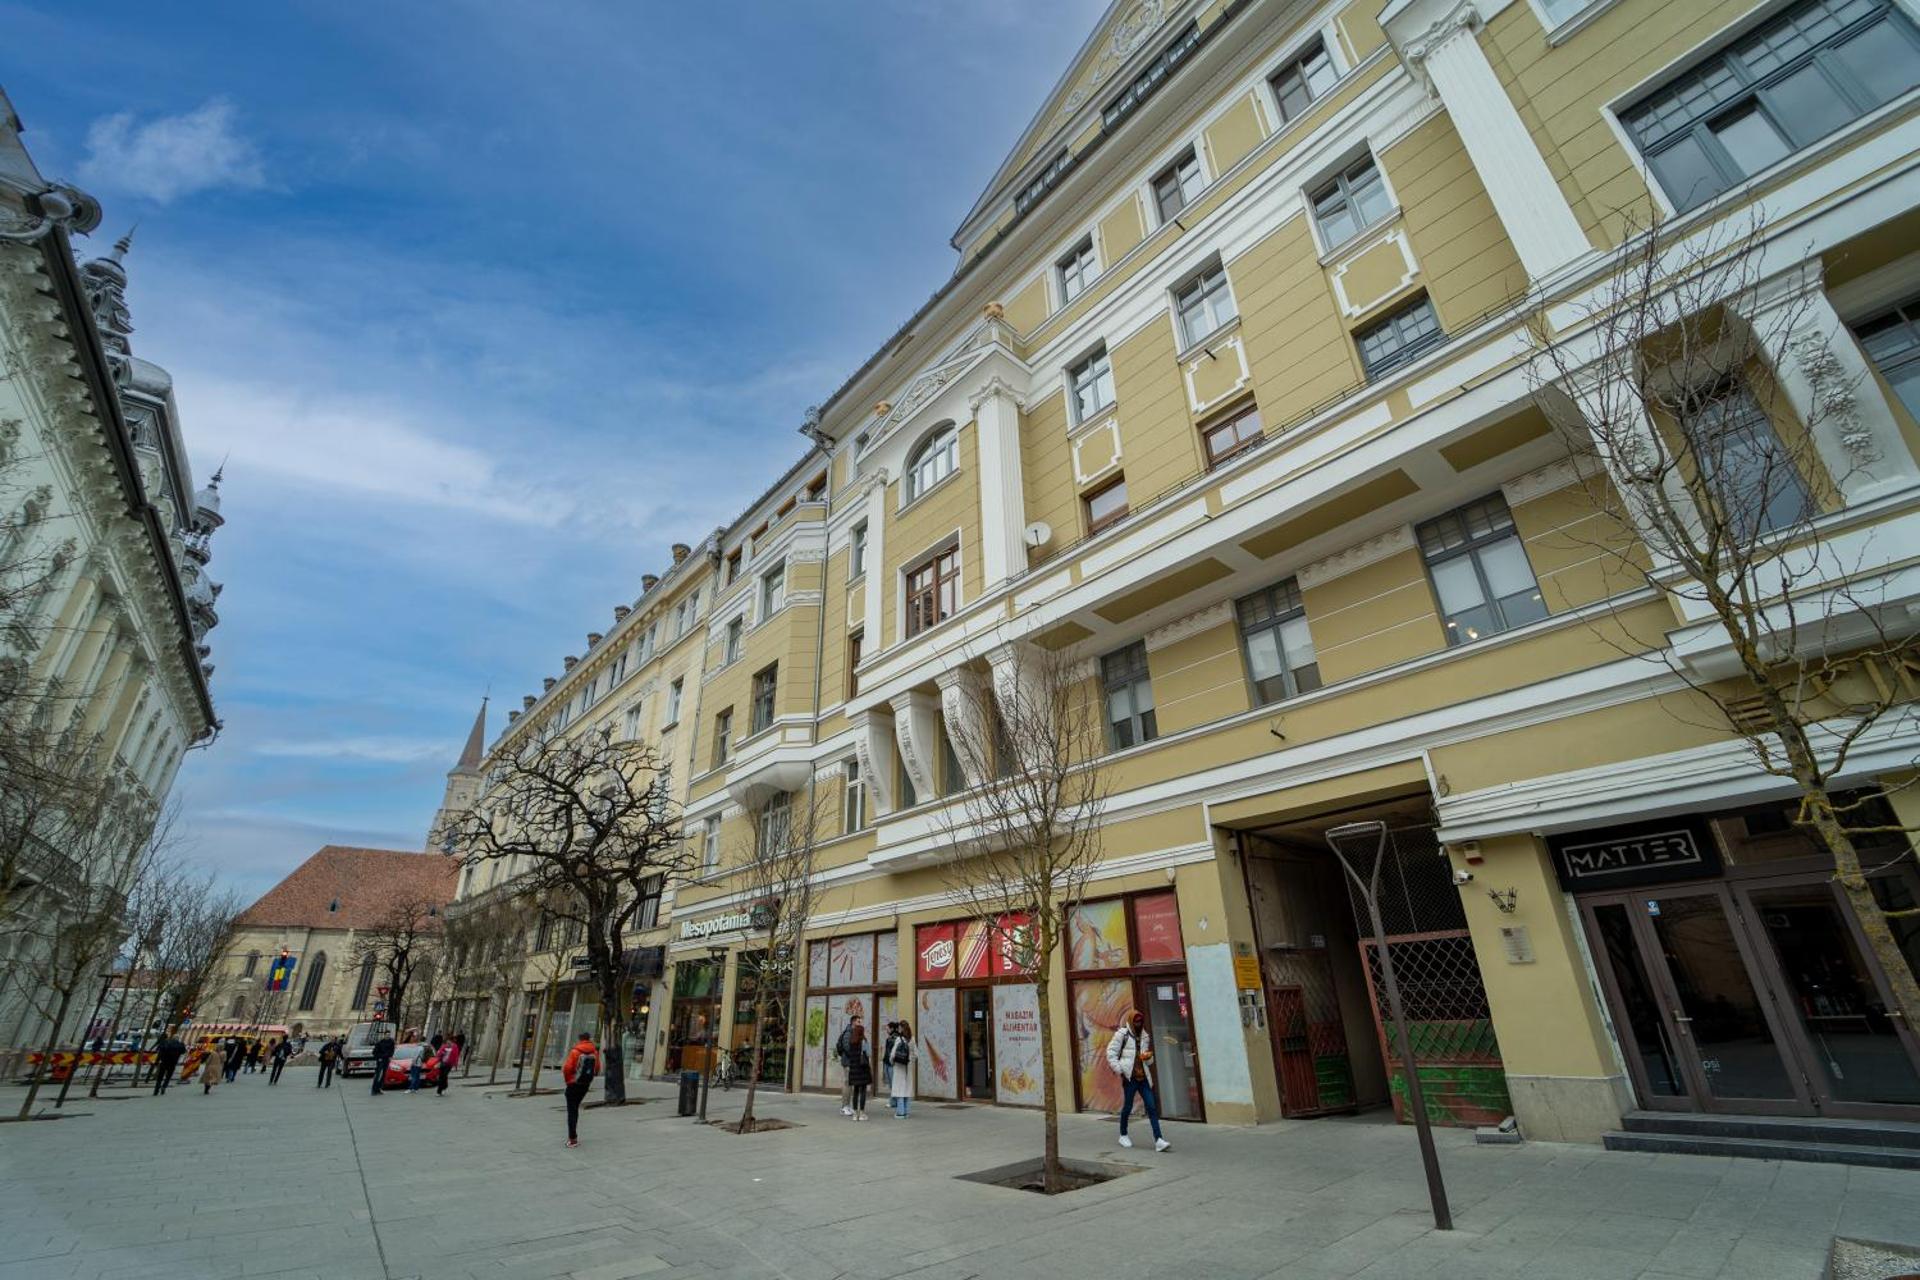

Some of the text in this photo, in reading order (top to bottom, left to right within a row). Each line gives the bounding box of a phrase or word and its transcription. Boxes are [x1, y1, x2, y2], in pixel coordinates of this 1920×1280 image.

[1570, 838, 1691, 869] MATTER
[681, 912, 751, 939] Mesopotamia
[1005, 1010, 1034, 1020] MAGAZIN
